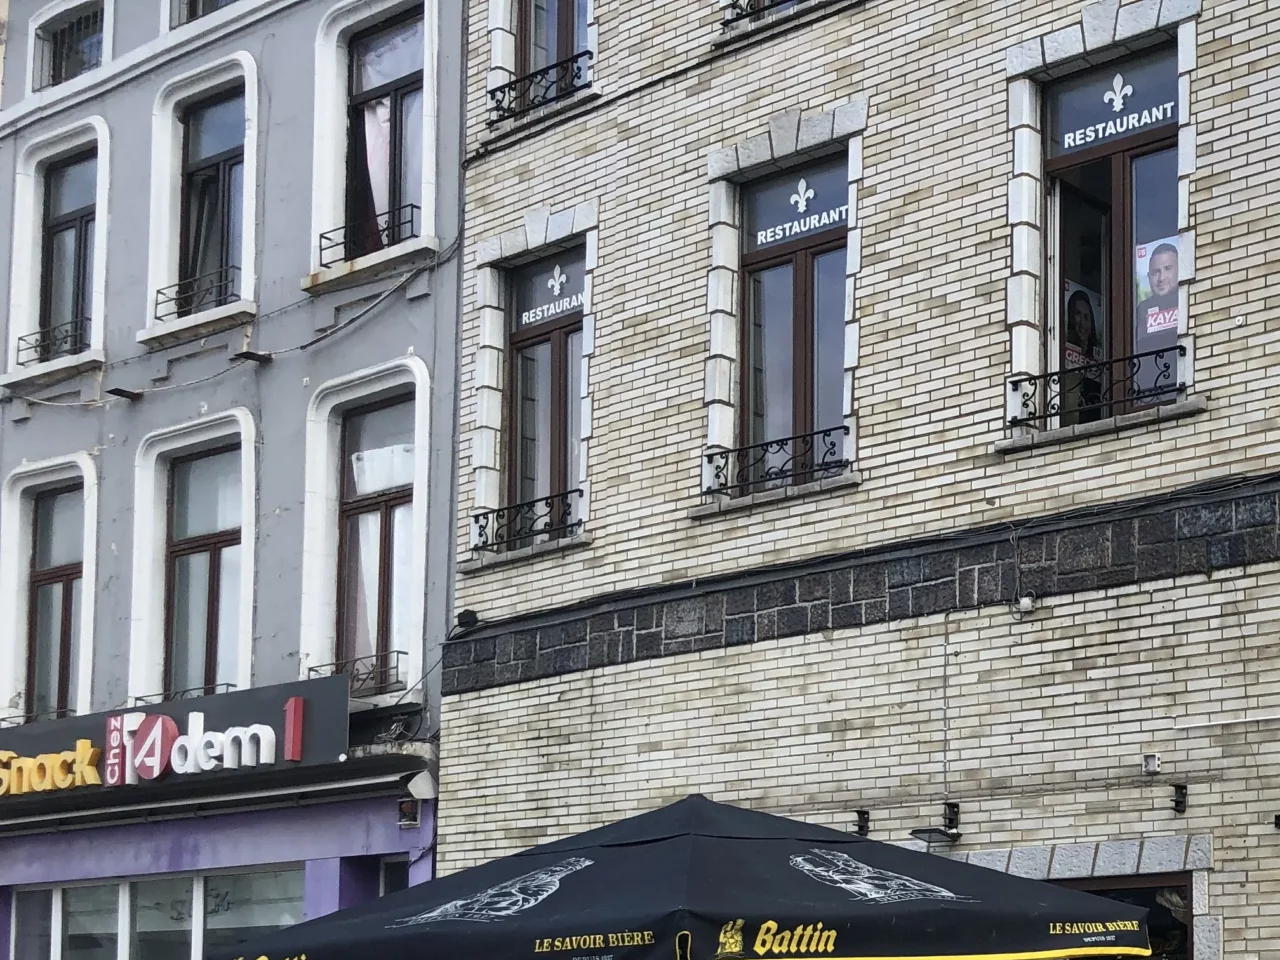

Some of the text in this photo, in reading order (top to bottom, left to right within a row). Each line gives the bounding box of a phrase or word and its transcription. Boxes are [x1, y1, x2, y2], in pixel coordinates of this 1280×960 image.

[1064, 101, 1175, 149] RESTAURANT
[757, 204, 848, 245] RESTAURANT
[1147, 310, 1179, 328] KAYA
[106, 715, 121, 785] Chez
[534, 929, 655, 952] LE SAVOIR BIÈRE
[753, 919, 838, 957] Battin
[1049, 920, 1139, 934] LE SAVOIR BIÈRE
